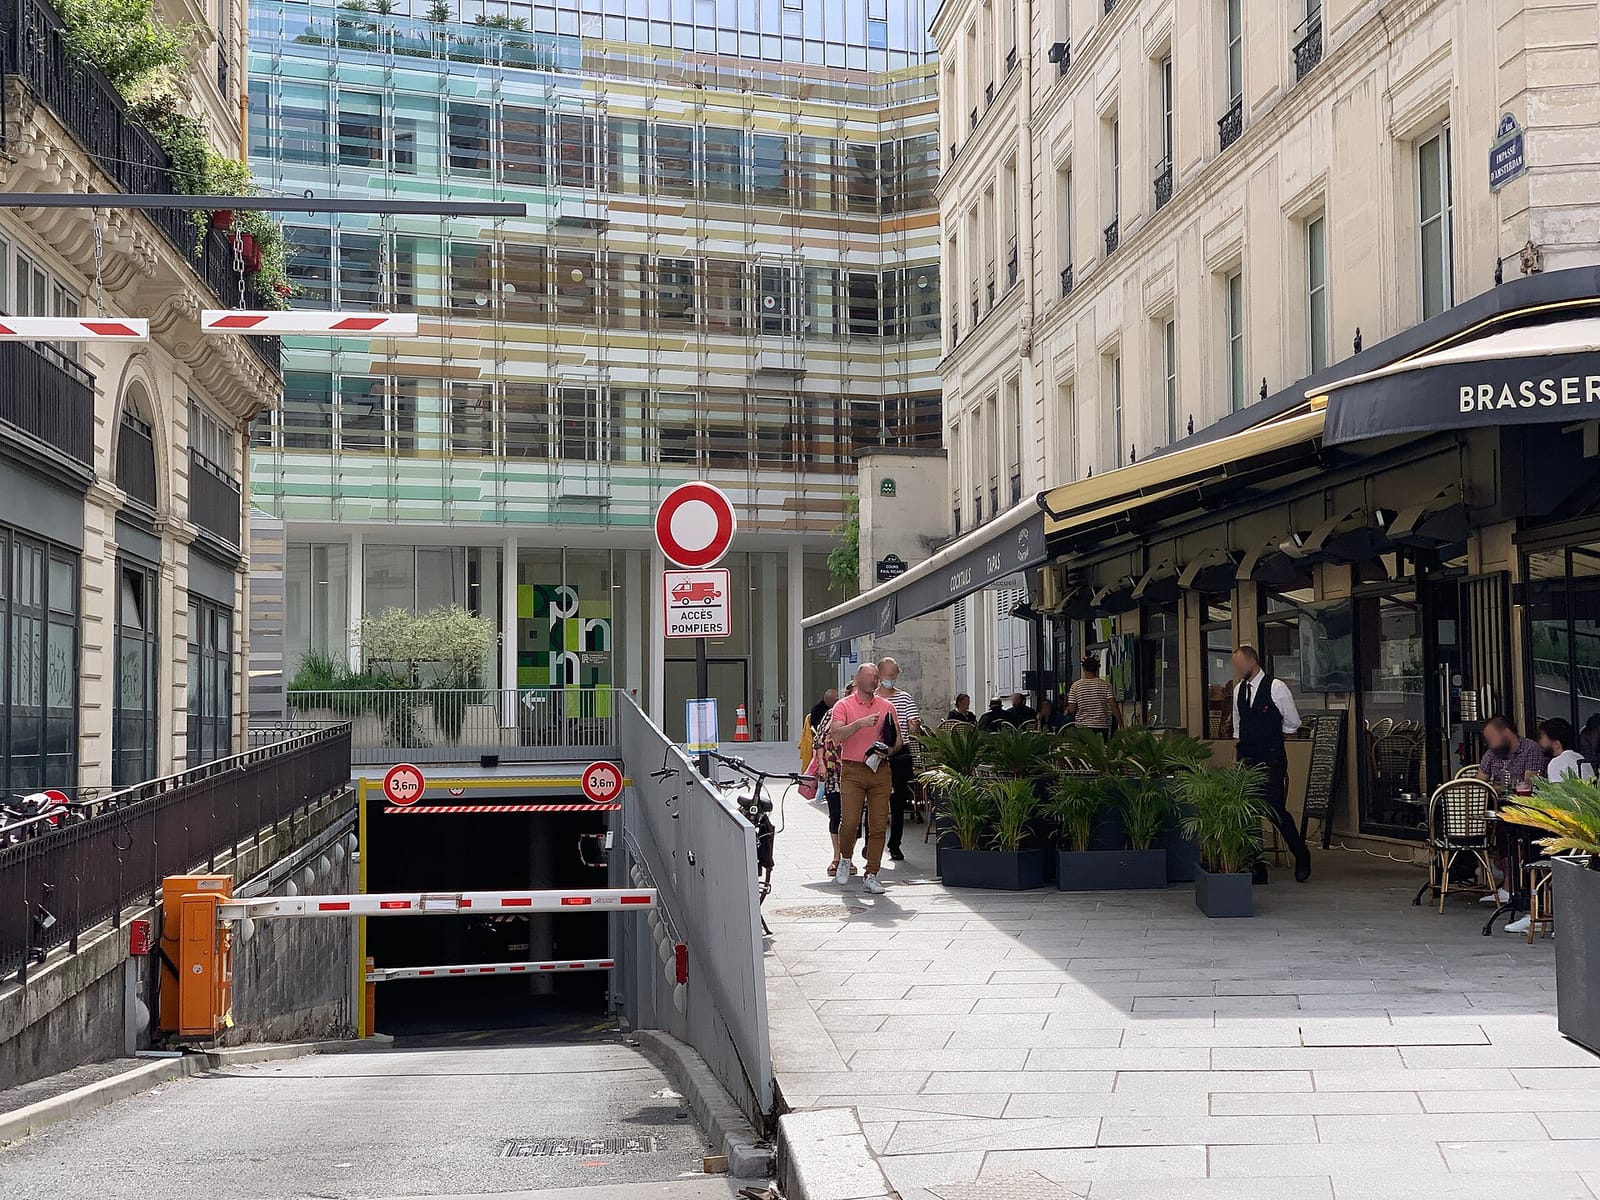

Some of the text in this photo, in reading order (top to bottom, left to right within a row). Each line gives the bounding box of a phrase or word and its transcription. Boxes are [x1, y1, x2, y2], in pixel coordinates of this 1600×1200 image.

[1496, 144, 1516, 164] IMPASSE
[1459, 375, 1600, 413] BRASSER
[680, 608, 713, 620] ACCÈS
[671, 623, 723, 634] POMPIERS
[392, 779, 417, 792] 3,6m
[590, 776, 615, 789] 3,6m
